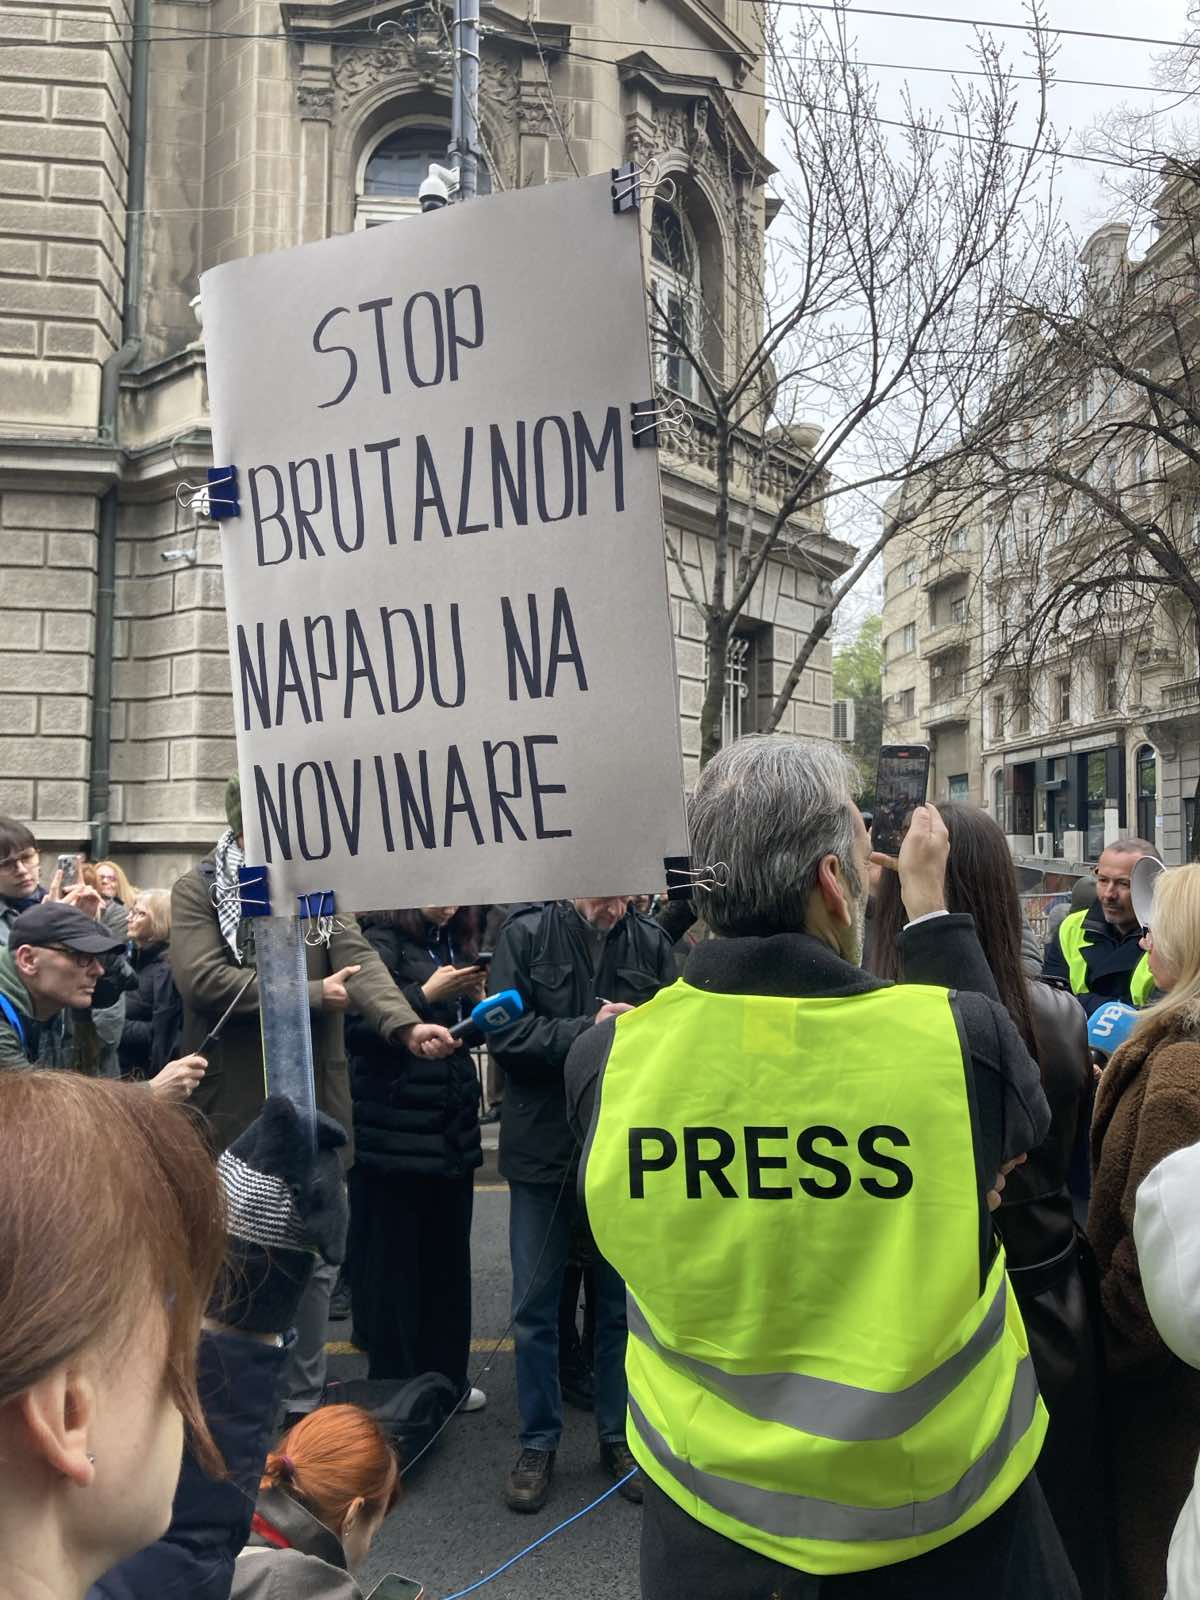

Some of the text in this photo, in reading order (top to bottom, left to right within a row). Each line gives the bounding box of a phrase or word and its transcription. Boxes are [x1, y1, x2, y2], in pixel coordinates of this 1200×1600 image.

[313, 285, 484, 408] STOP
[248, 407, 624, 566] BRUTALNOM
[237, 587, 588, 730] NAPADU NA
[254, 735, 572, 864] NOVINARE
[629, 1125, 913, 1200] PRESS
